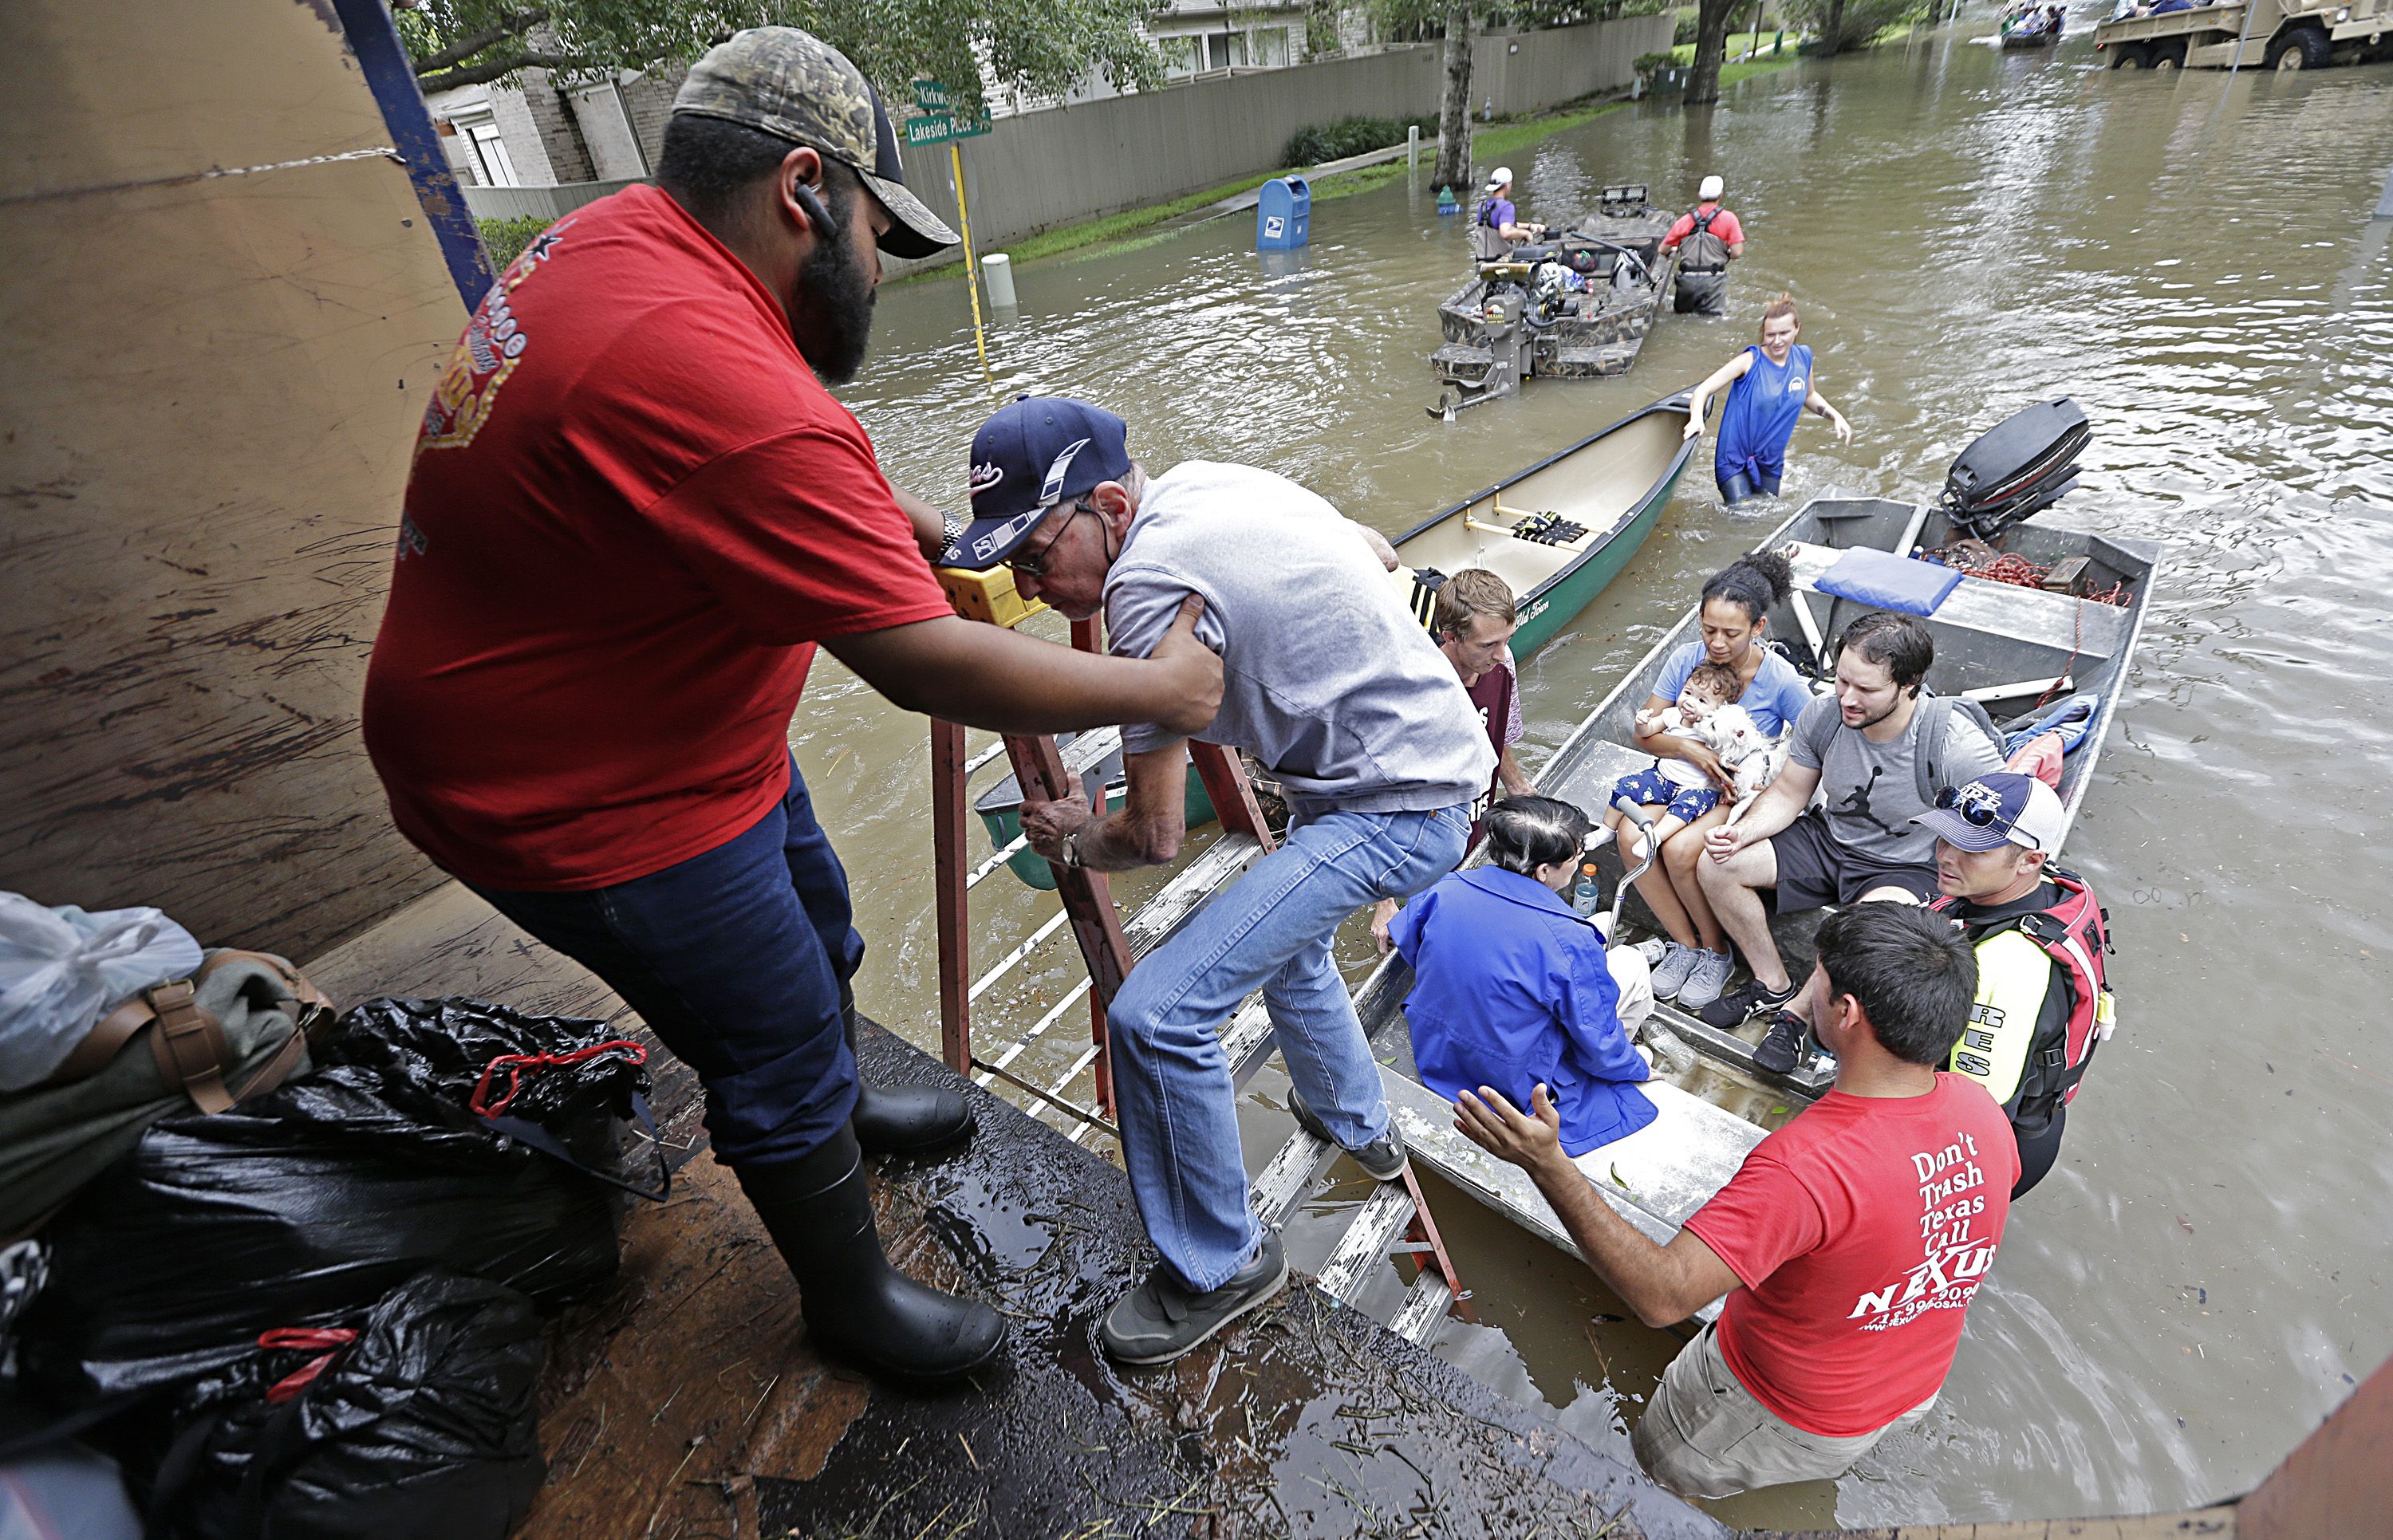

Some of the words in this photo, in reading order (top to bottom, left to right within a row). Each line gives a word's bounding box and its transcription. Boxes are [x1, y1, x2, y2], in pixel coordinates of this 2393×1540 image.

[920, 85, 960, 104] Kirkw
[909, 119, 948, 142] Lakeside
[1515, 608, 1531, 630] Old
[1530, 598, 1550, 620] Town
[1910, 1131, 1979, 1184] Don't
[1918, 1160, 1985, 1212] Trash
[1919, 1195, 1985, 1238] Texas
[1924, 1219, 1971, 1257] Call
[1846, 1238, 1997, 1319] NEXUS
